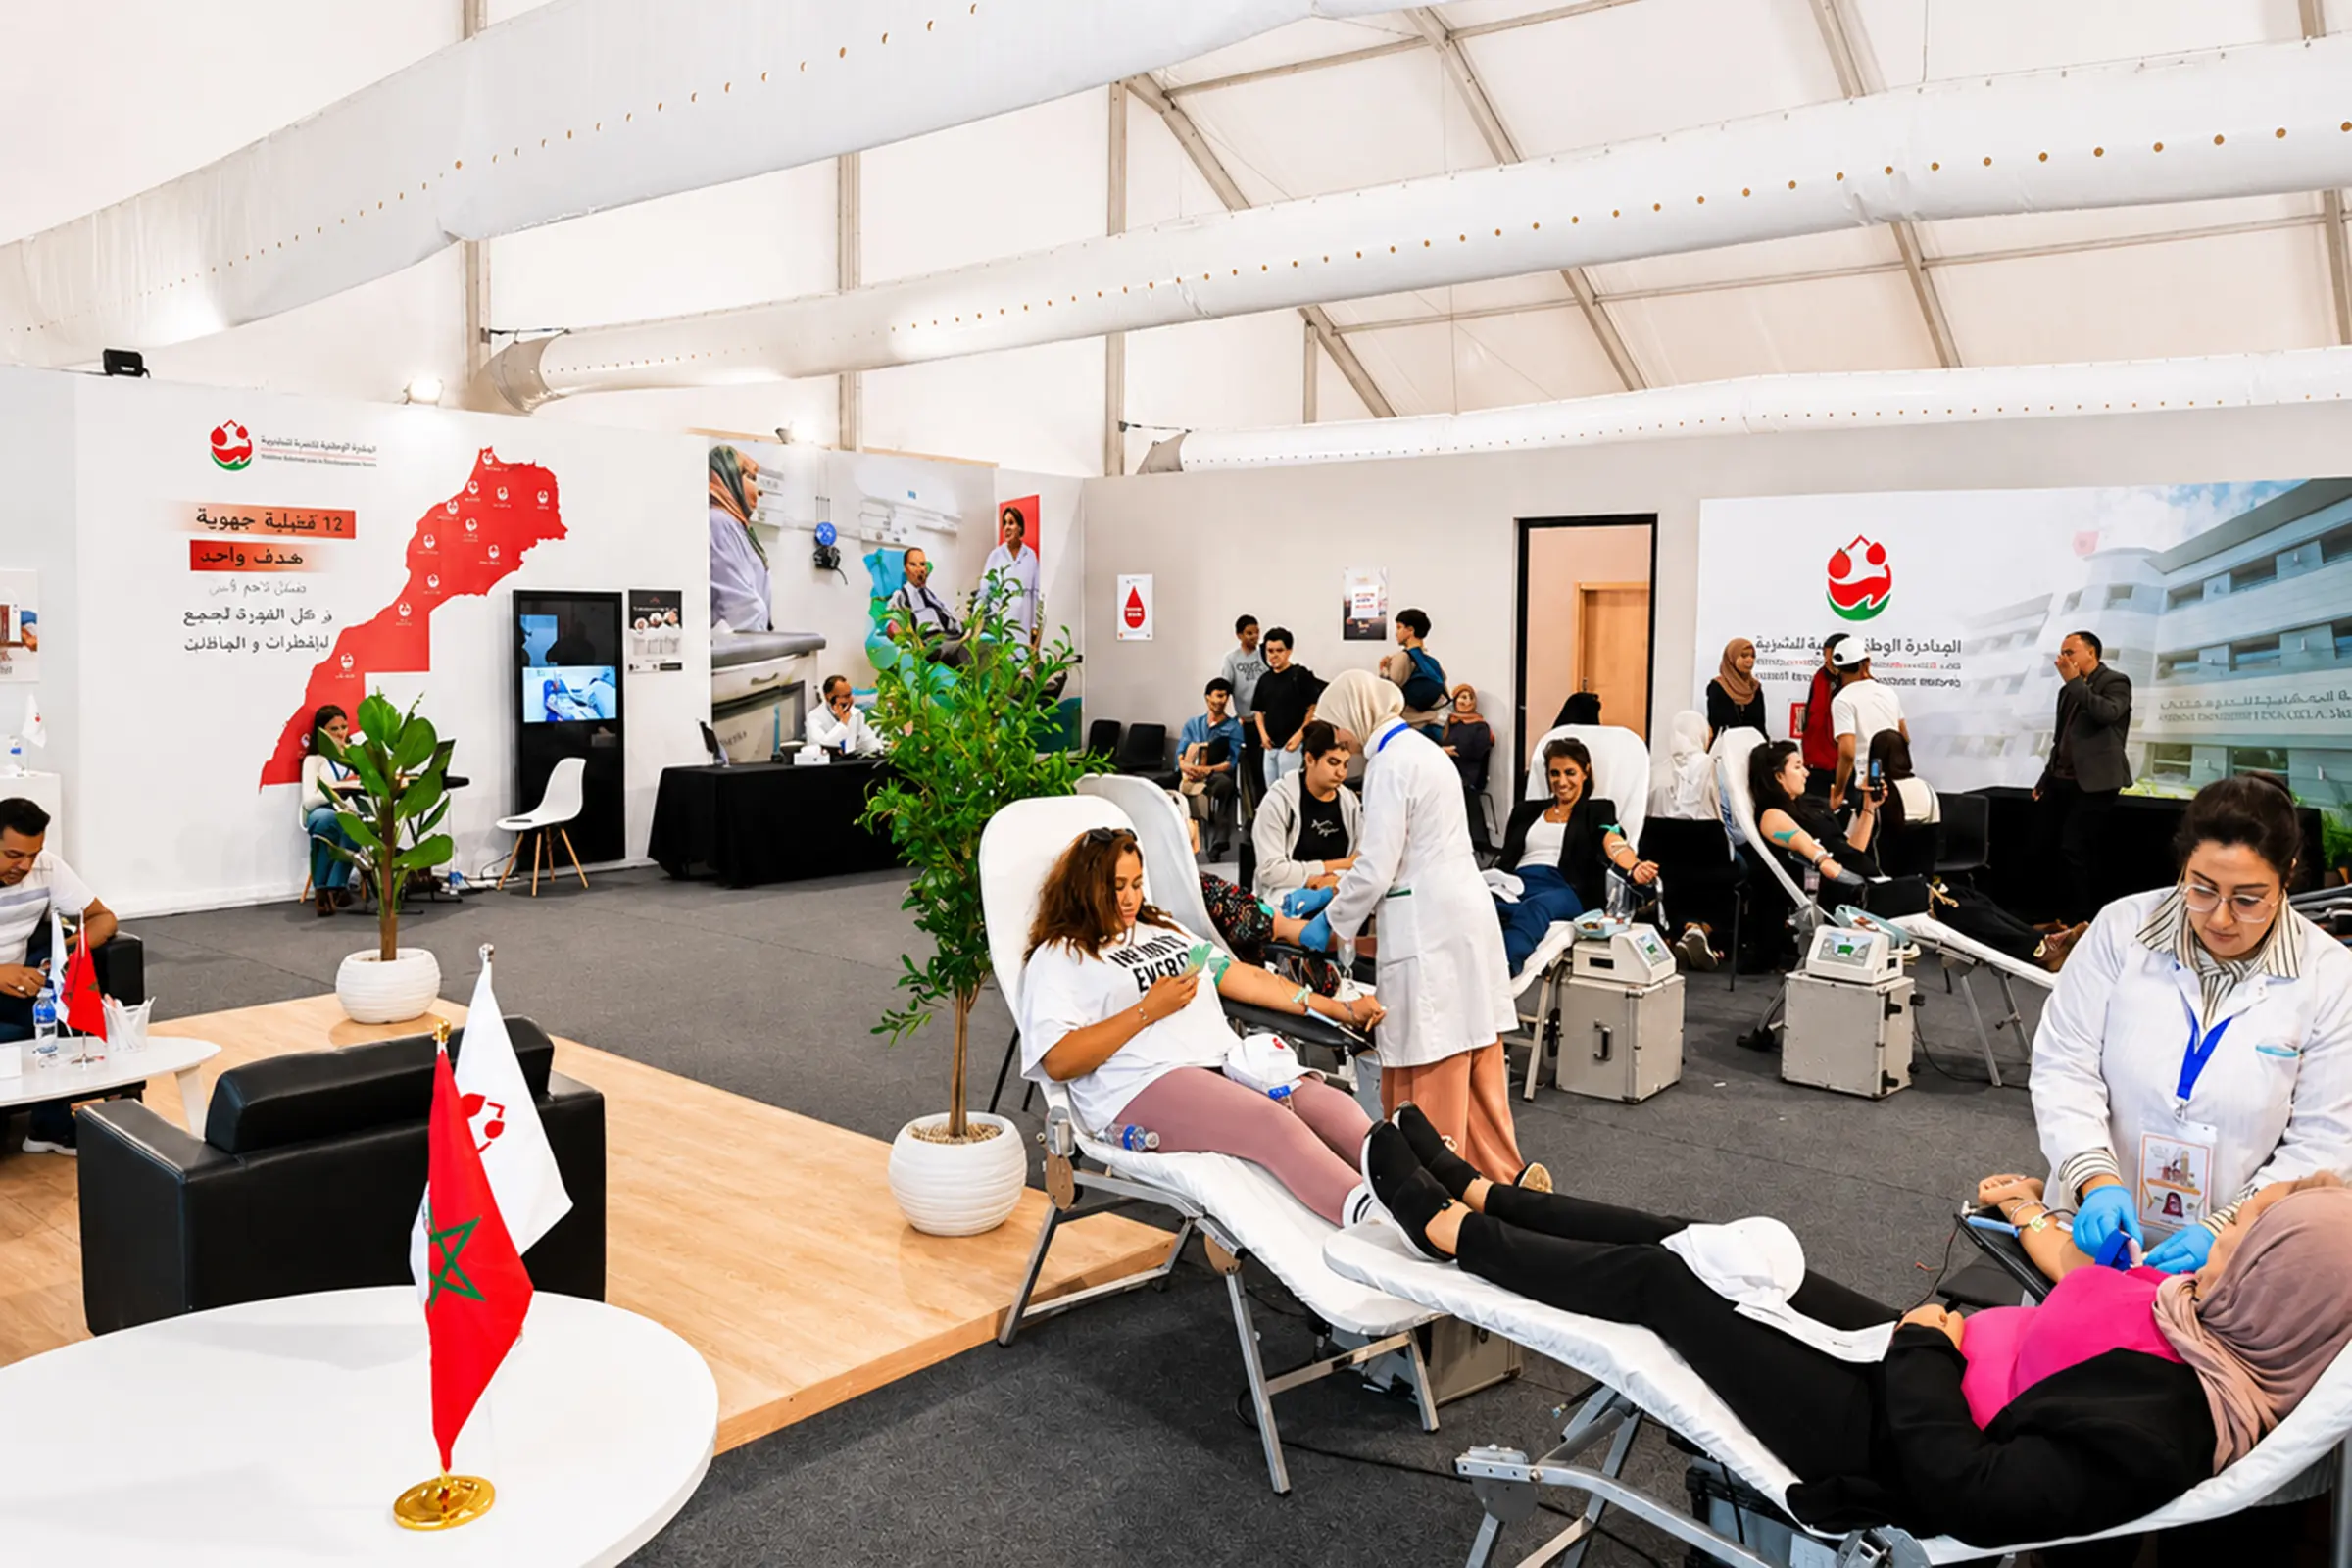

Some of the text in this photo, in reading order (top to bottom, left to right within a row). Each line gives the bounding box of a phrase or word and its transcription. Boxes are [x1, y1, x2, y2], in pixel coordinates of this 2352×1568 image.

[323, 516, 343, 531] 12
[200, 546, 304, 565] هدف واحد
